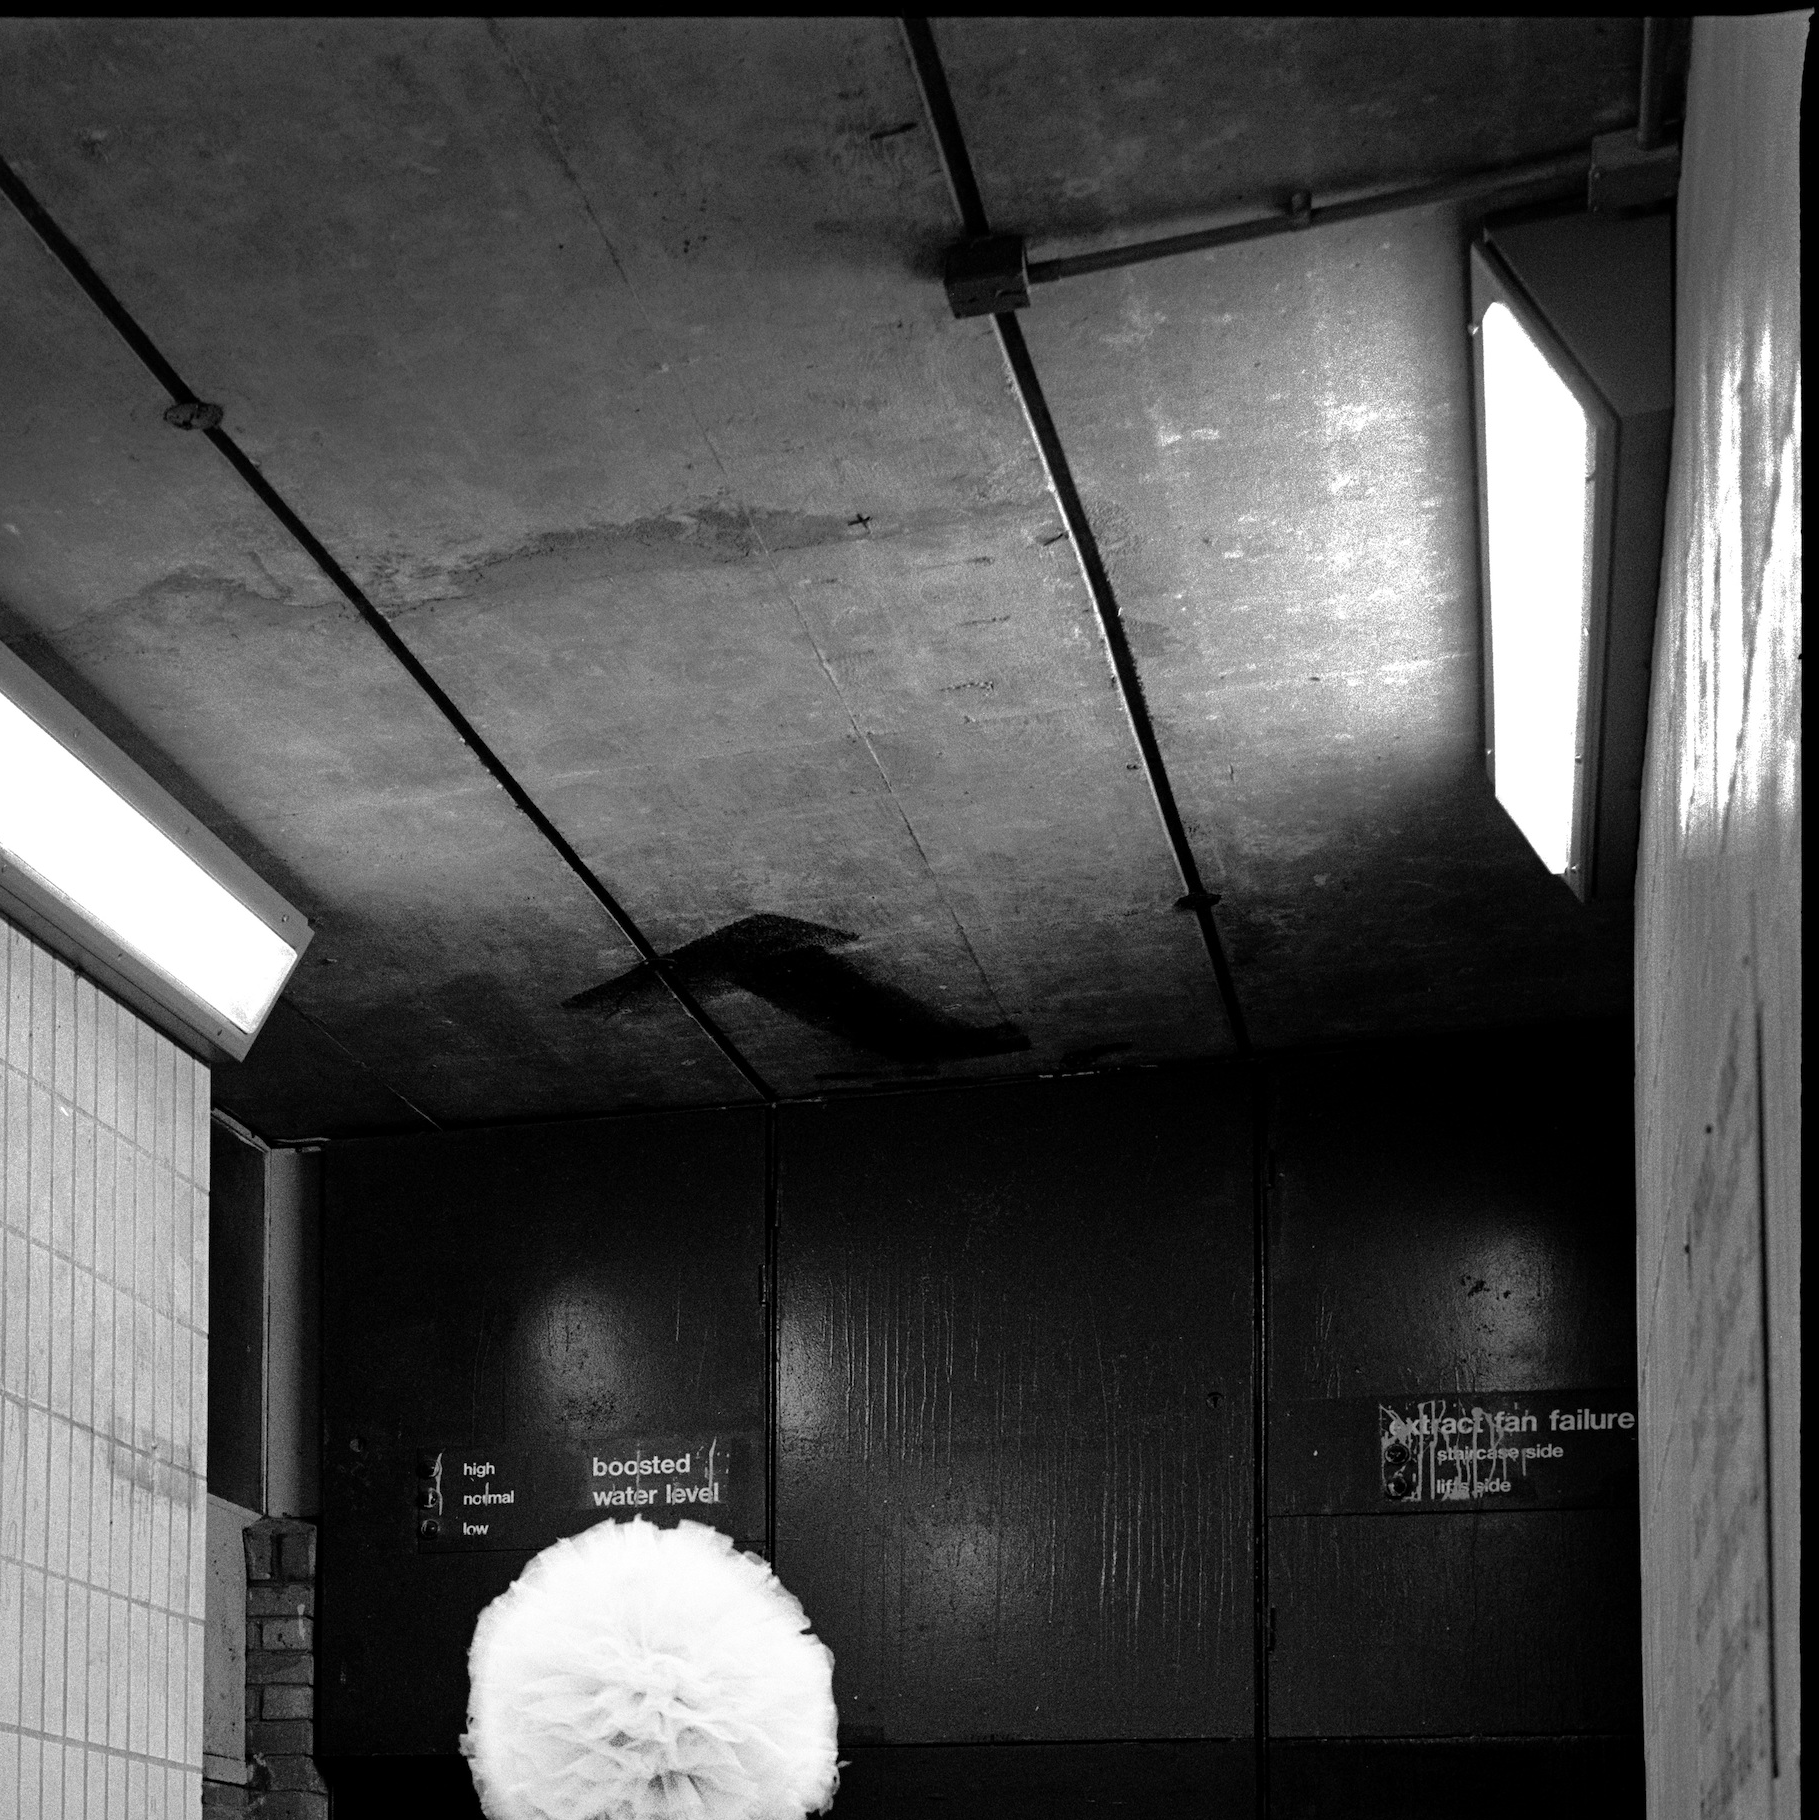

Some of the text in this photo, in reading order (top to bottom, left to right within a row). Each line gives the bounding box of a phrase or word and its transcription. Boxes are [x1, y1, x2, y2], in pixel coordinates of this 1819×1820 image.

[1494, 1410, 1538, 1433] fan
[1548, 1408, 1636, 1432] failure
[1436, 1443, 1565, 1463] staircase side
[462, 1462, 496, 1479] high
[592, 1453, 692, 1478] boosted
[1476, 1477, 1512, 1493] side
[462, 1490, 515, 1506] normal
[592, 1482, 721, 1507] water level
[462, 1522, 490, 1536] low
